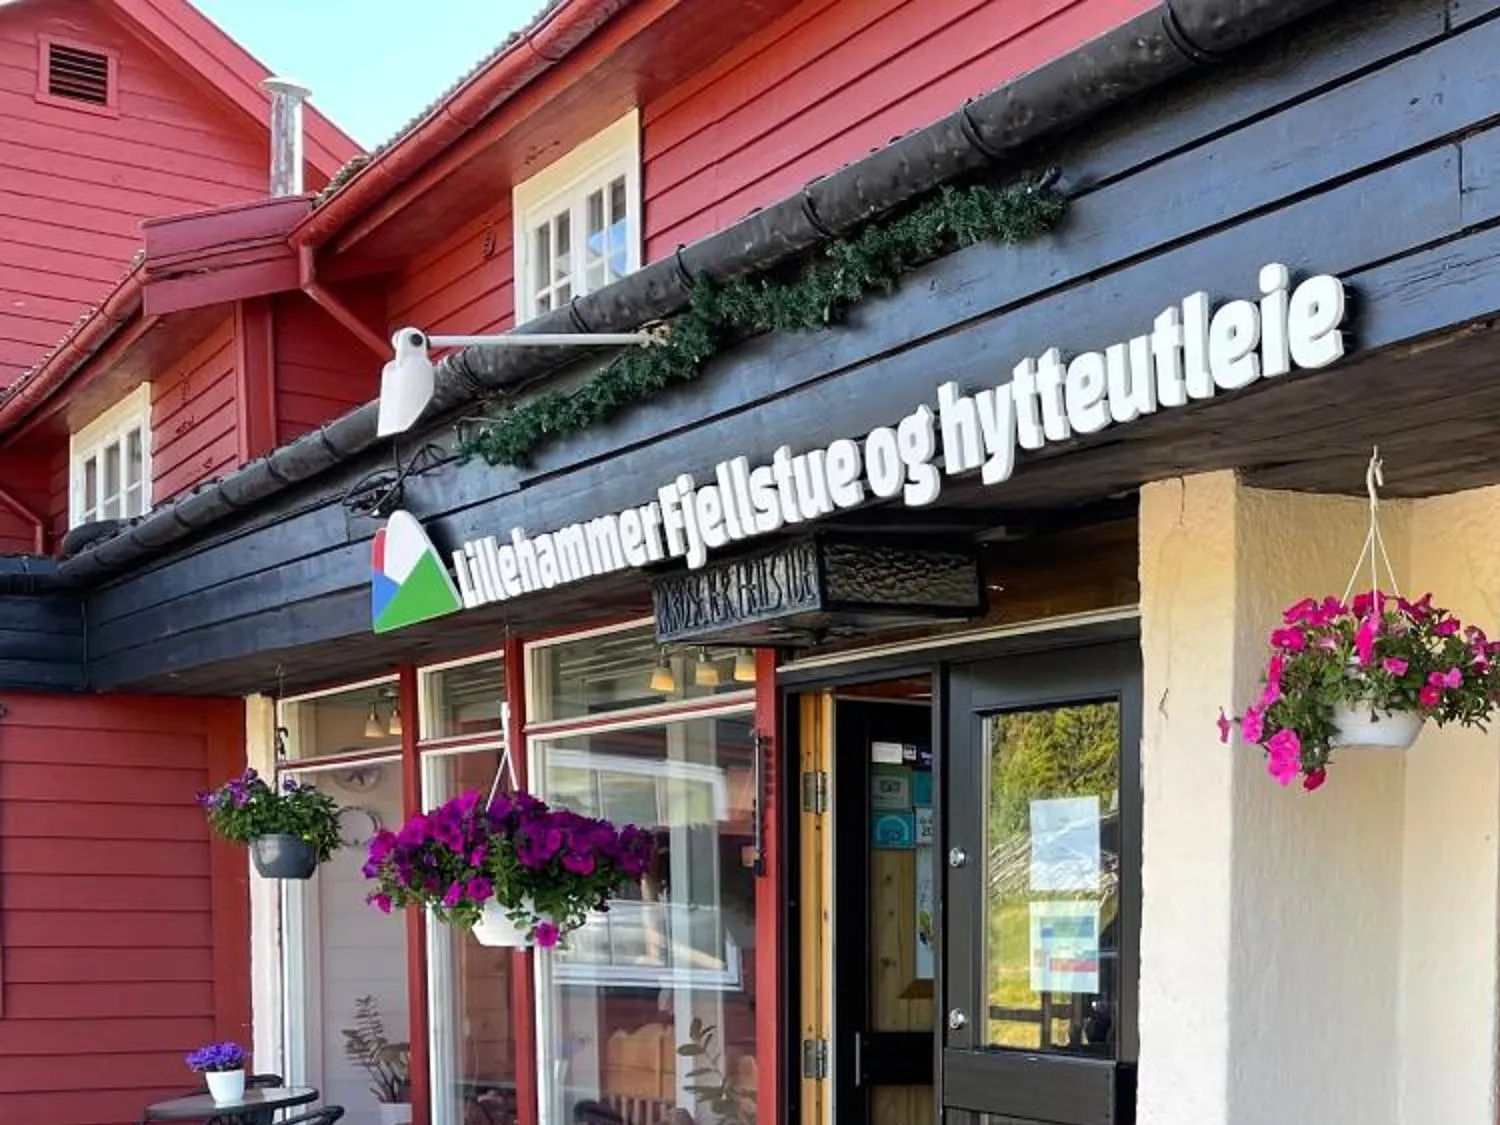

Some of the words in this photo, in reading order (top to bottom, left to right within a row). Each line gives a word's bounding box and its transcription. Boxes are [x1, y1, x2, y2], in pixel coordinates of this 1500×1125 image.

[452, 501, 664, 609] Lillehammer
[658, 439, 865, 569] Fjellstue
[865, 404, 941, 507] og
[938, 263, 1346, 485] hytteutleie
